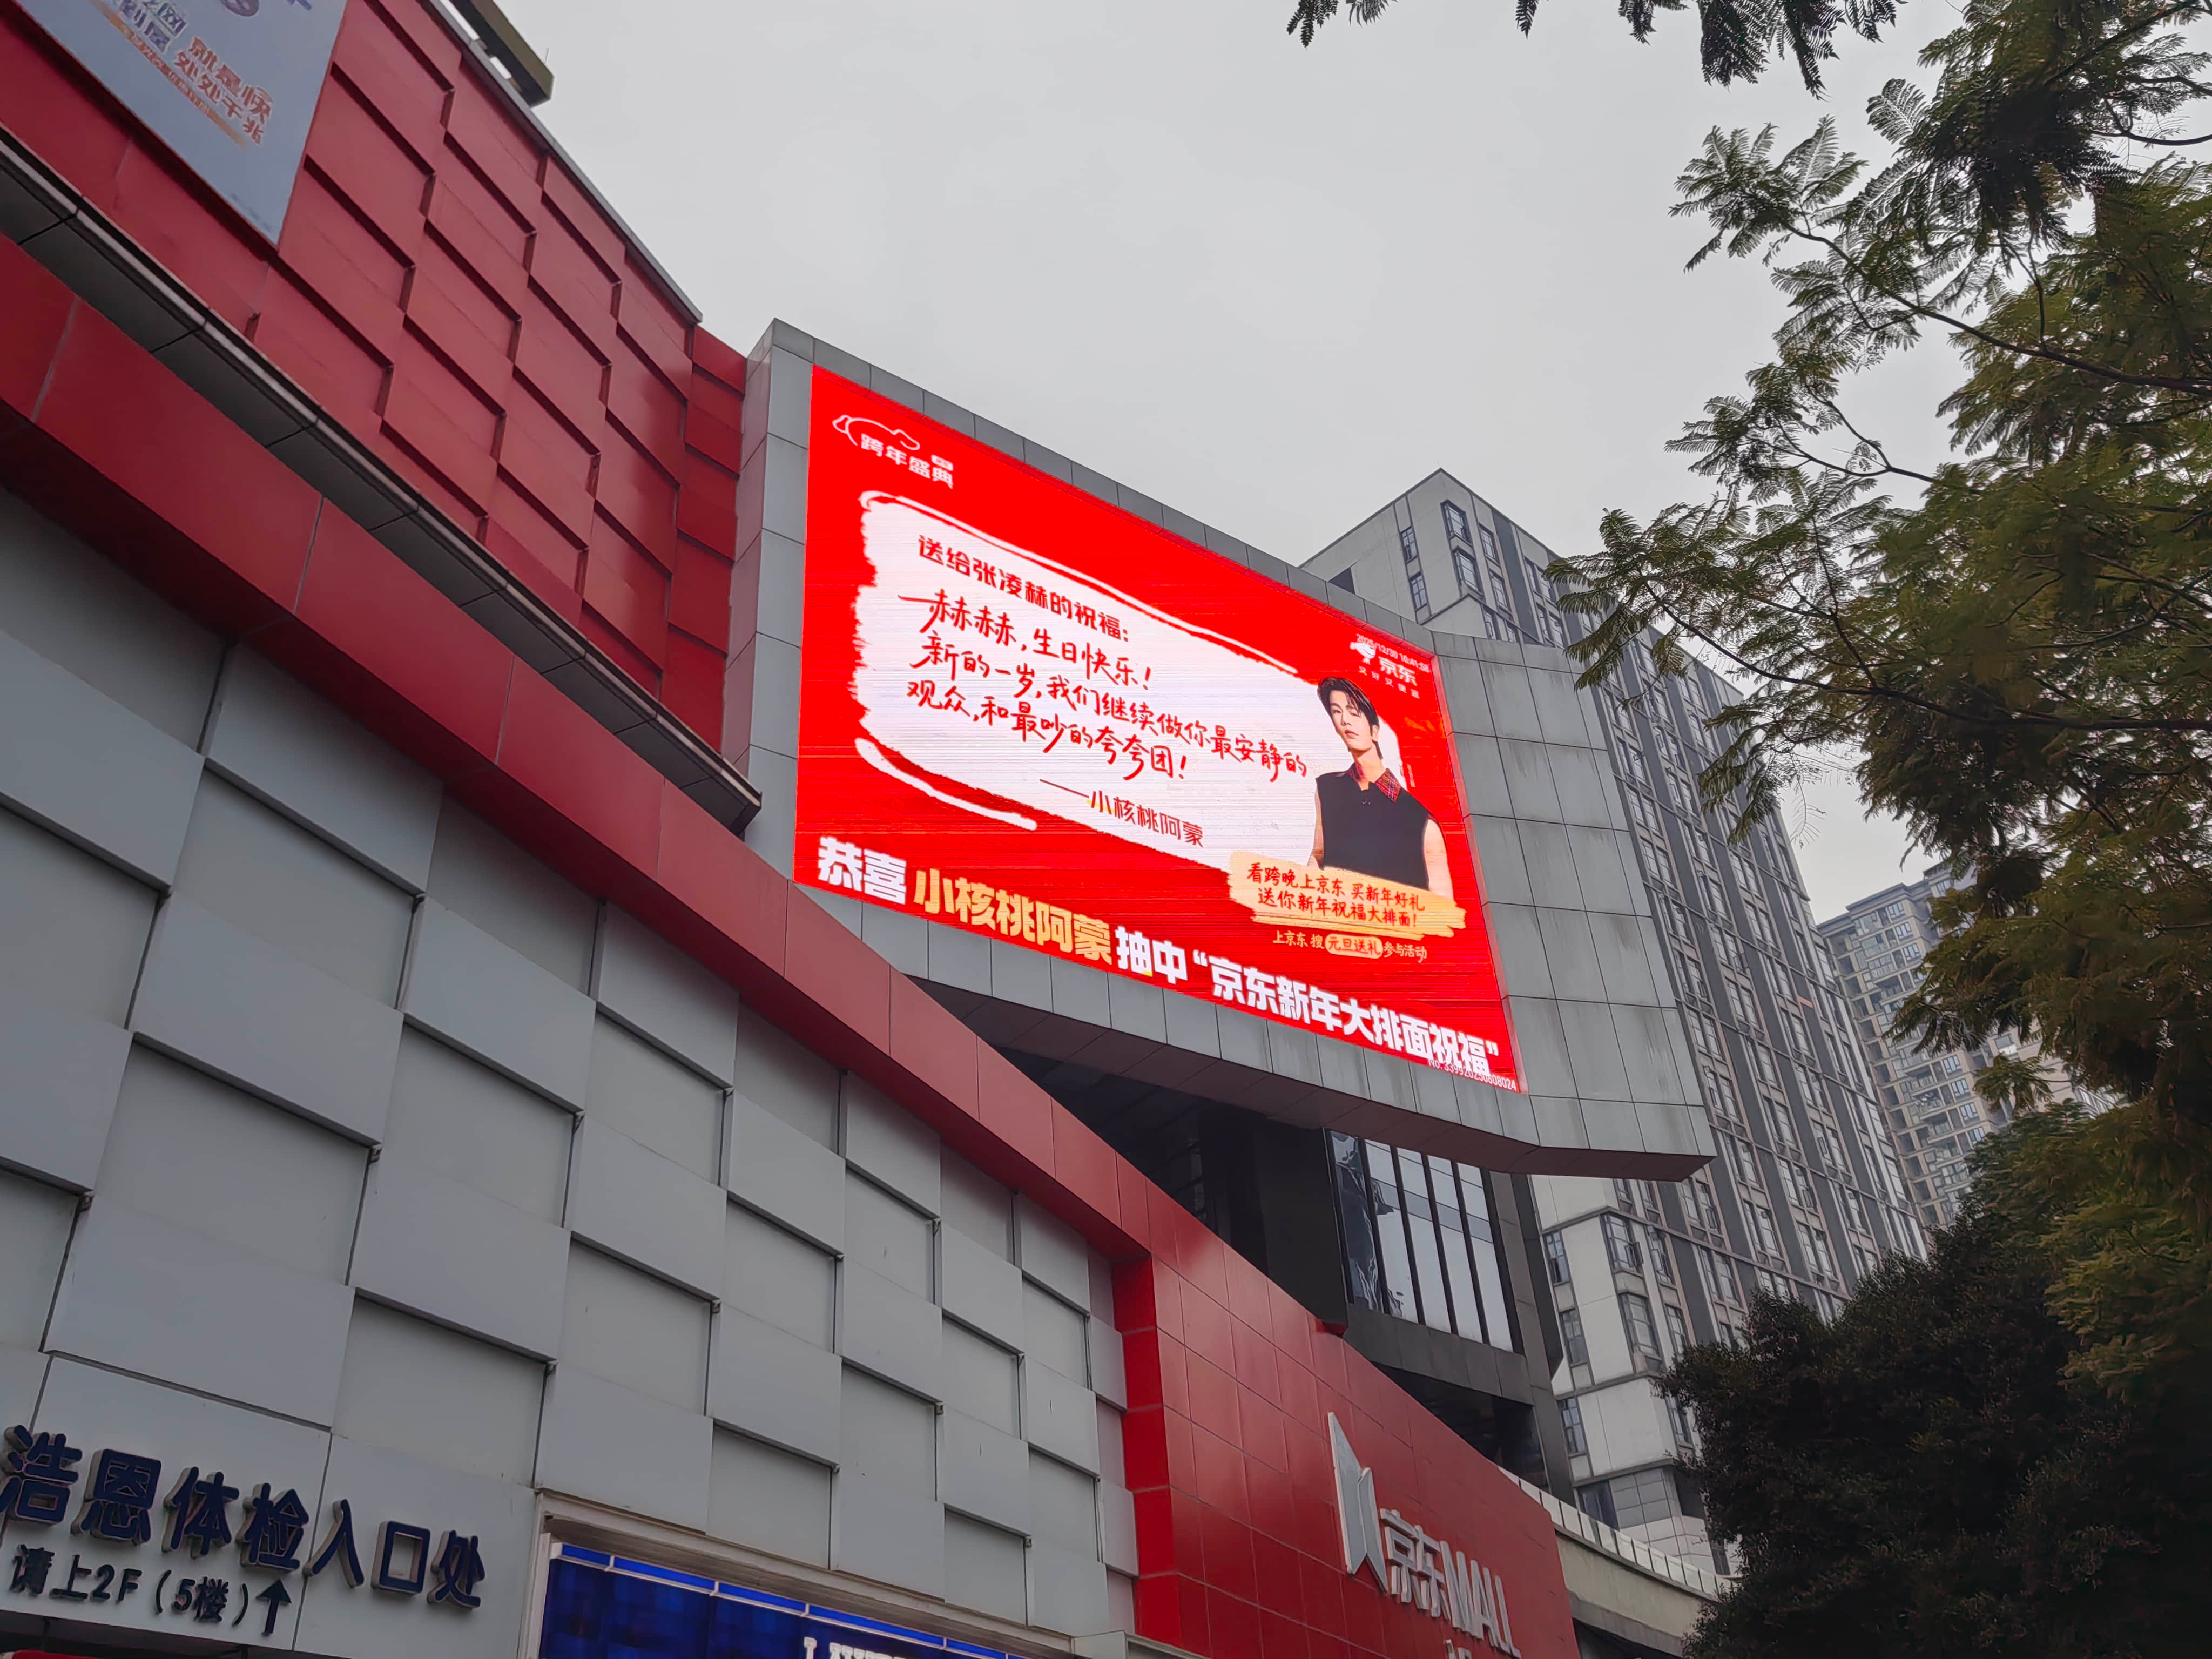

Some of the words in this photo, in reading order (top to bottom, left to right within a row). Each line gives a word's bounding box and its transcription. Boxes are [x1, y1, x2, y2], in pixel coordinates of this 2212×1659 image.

[174, 51, 264, 146] 处处千兆
[861, 433, 954, 489] 跨年盛典
[918, 535, 1129, 643] 送给张凌赫的祝福：
[1378, 656, 1418, 686] 京东
[818, 835, 907, 905] 恭喜
[914, 868, 1112, 965] 小核桃阿蒙
[1115, 925, 1188, 984] 抽中
[1257, 888, 1418, 927] 送你新年祝福大排面！
[1383, 941, 1427, 963] 参与活动
[0, 1425, 485, 1610] 浩恩体检入口处
[1380, 1508, 1521, 1659] 京东MALL
